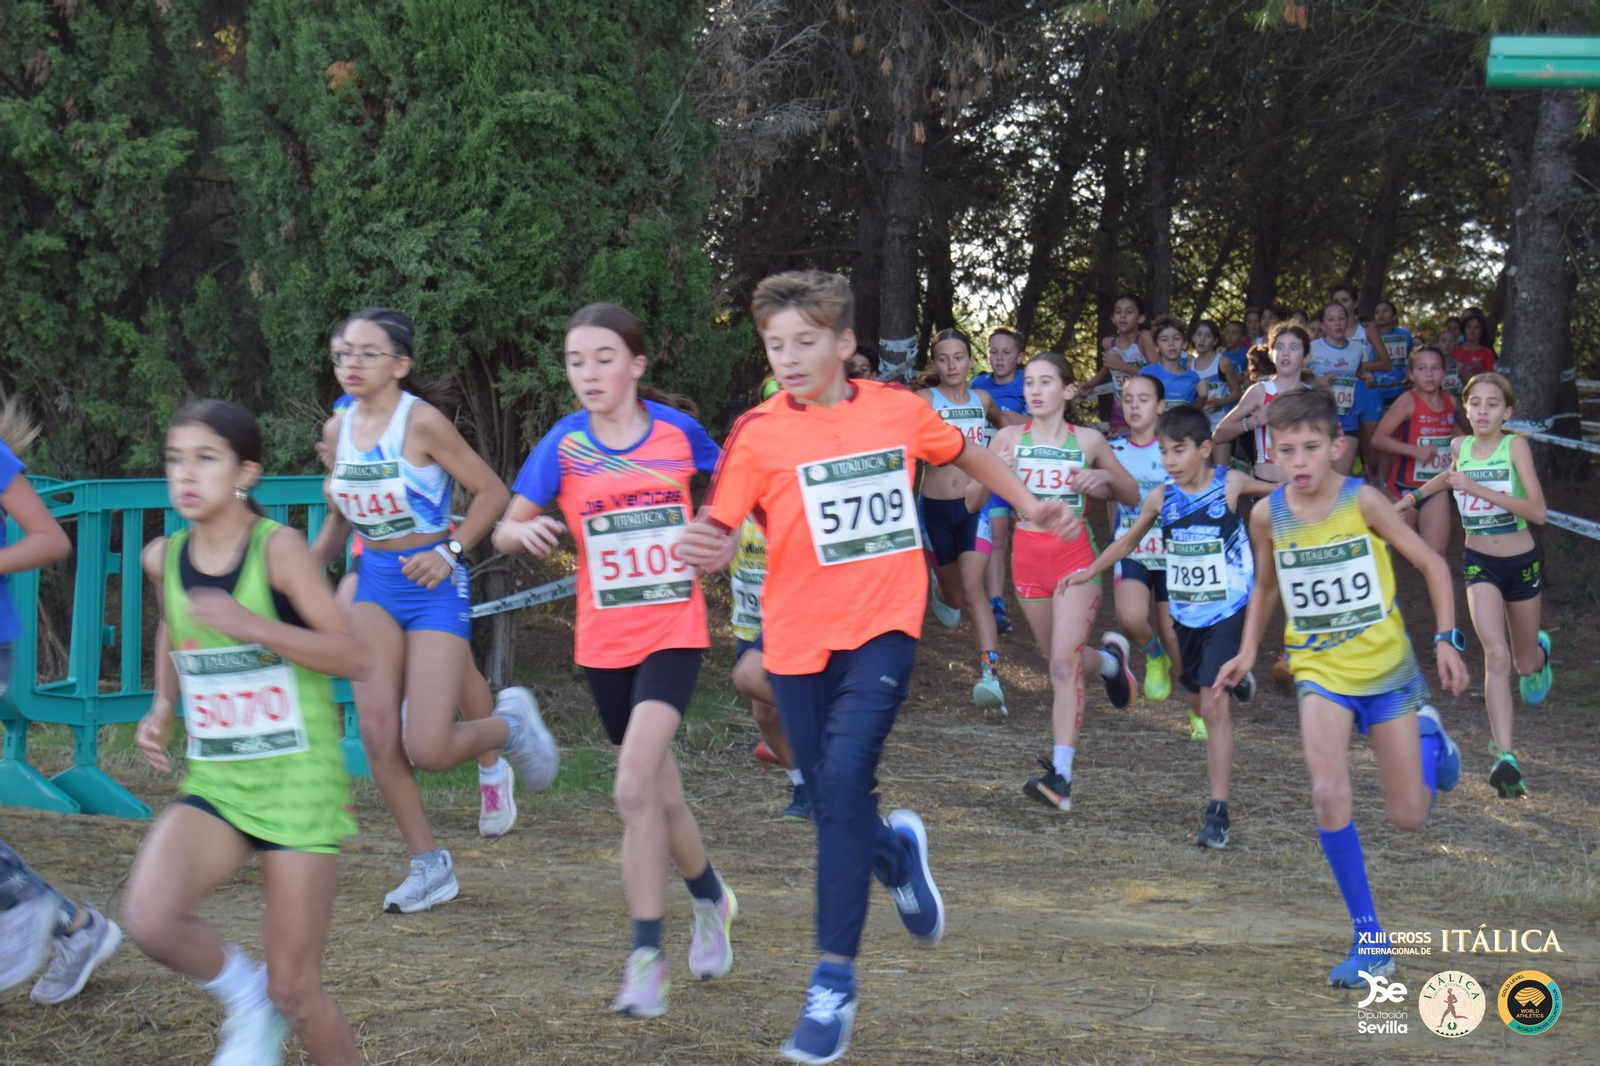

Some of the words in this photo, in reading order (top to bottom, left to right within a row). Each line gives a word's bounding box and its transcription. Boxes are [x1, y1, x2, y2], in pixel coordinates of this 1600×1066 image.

[1020, 467, 1077, 490] 7134
[337, 492, 405, 518] 7141
[820, 488, 904, 535] 5709
[600, 543, 688, 581] 5109
[1171, 564, 1222, 587] 7891
[1290, 571, 1372, 609] 5619
[189, 685, 291, 729] 5070
